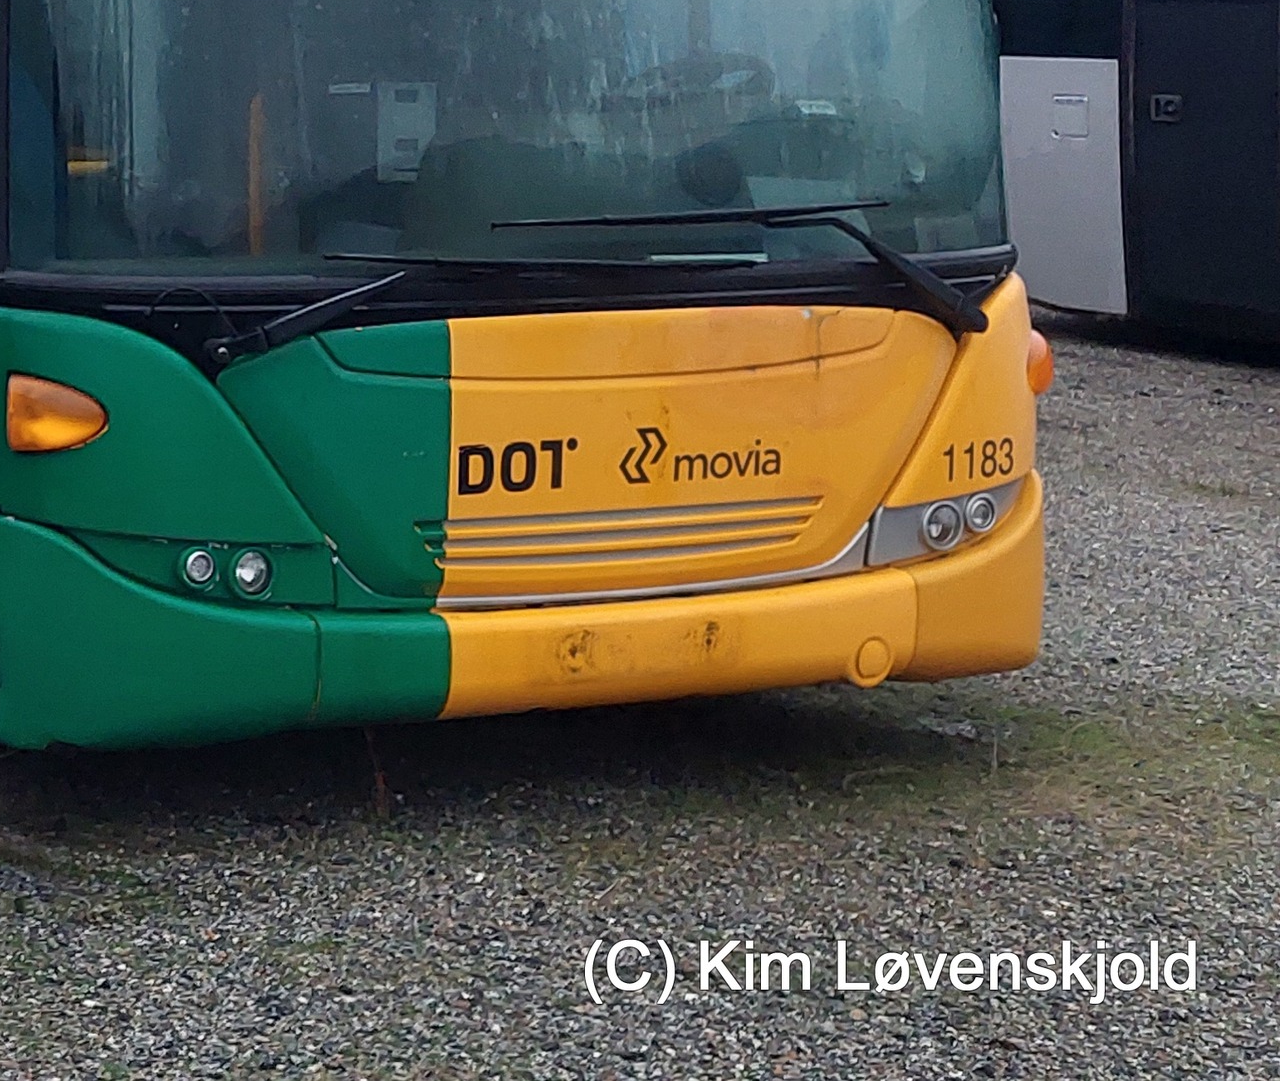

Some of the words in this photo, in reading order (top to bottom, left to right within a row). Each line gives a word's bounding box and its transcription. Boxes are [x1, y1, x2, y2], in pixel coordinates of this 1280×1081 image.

[458, 437, 578, 496] DOT
[673, 438, 782, 483] movia
[943, 437, 1014, 481] 1183
